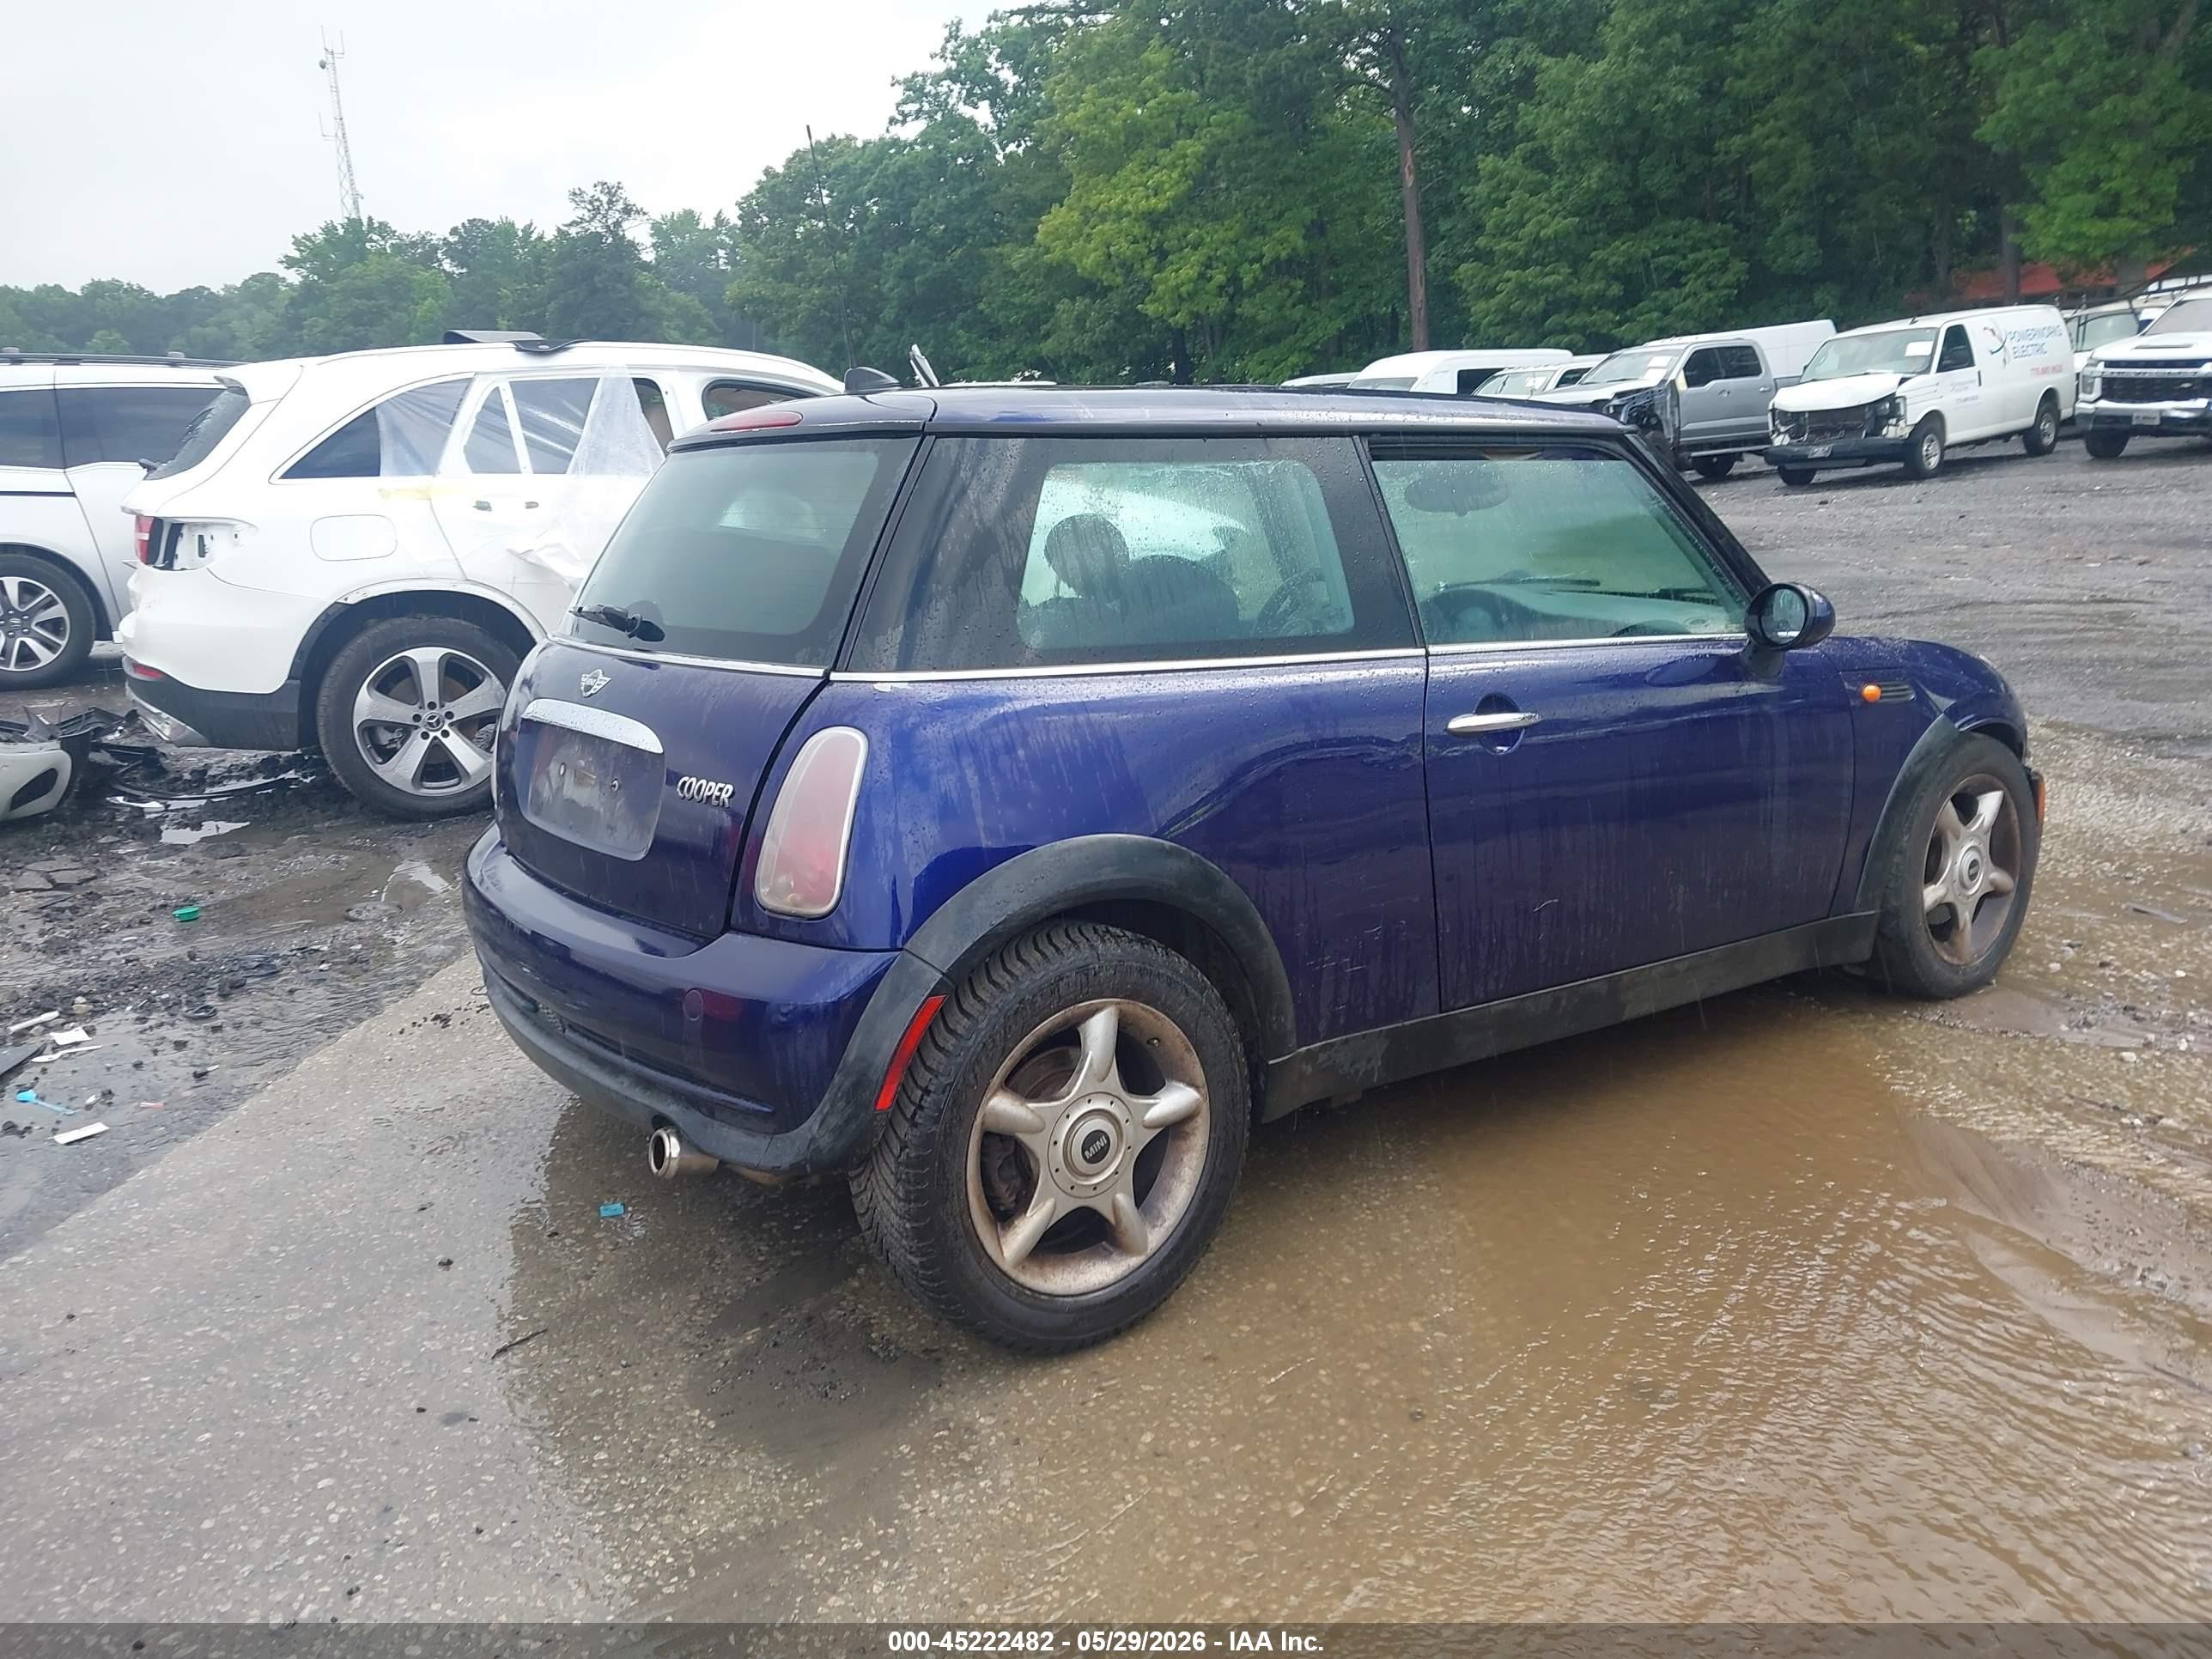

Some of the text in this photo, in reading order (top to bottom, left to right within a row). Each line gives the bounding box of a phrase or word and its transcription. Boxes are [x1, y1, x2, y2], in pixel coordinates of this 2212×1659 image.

[2013, 342, 2048, 358] ELECTRIC
[677, 776, 734, 808] COOPER
[1084, 1135, 1108, 1160] MINI
